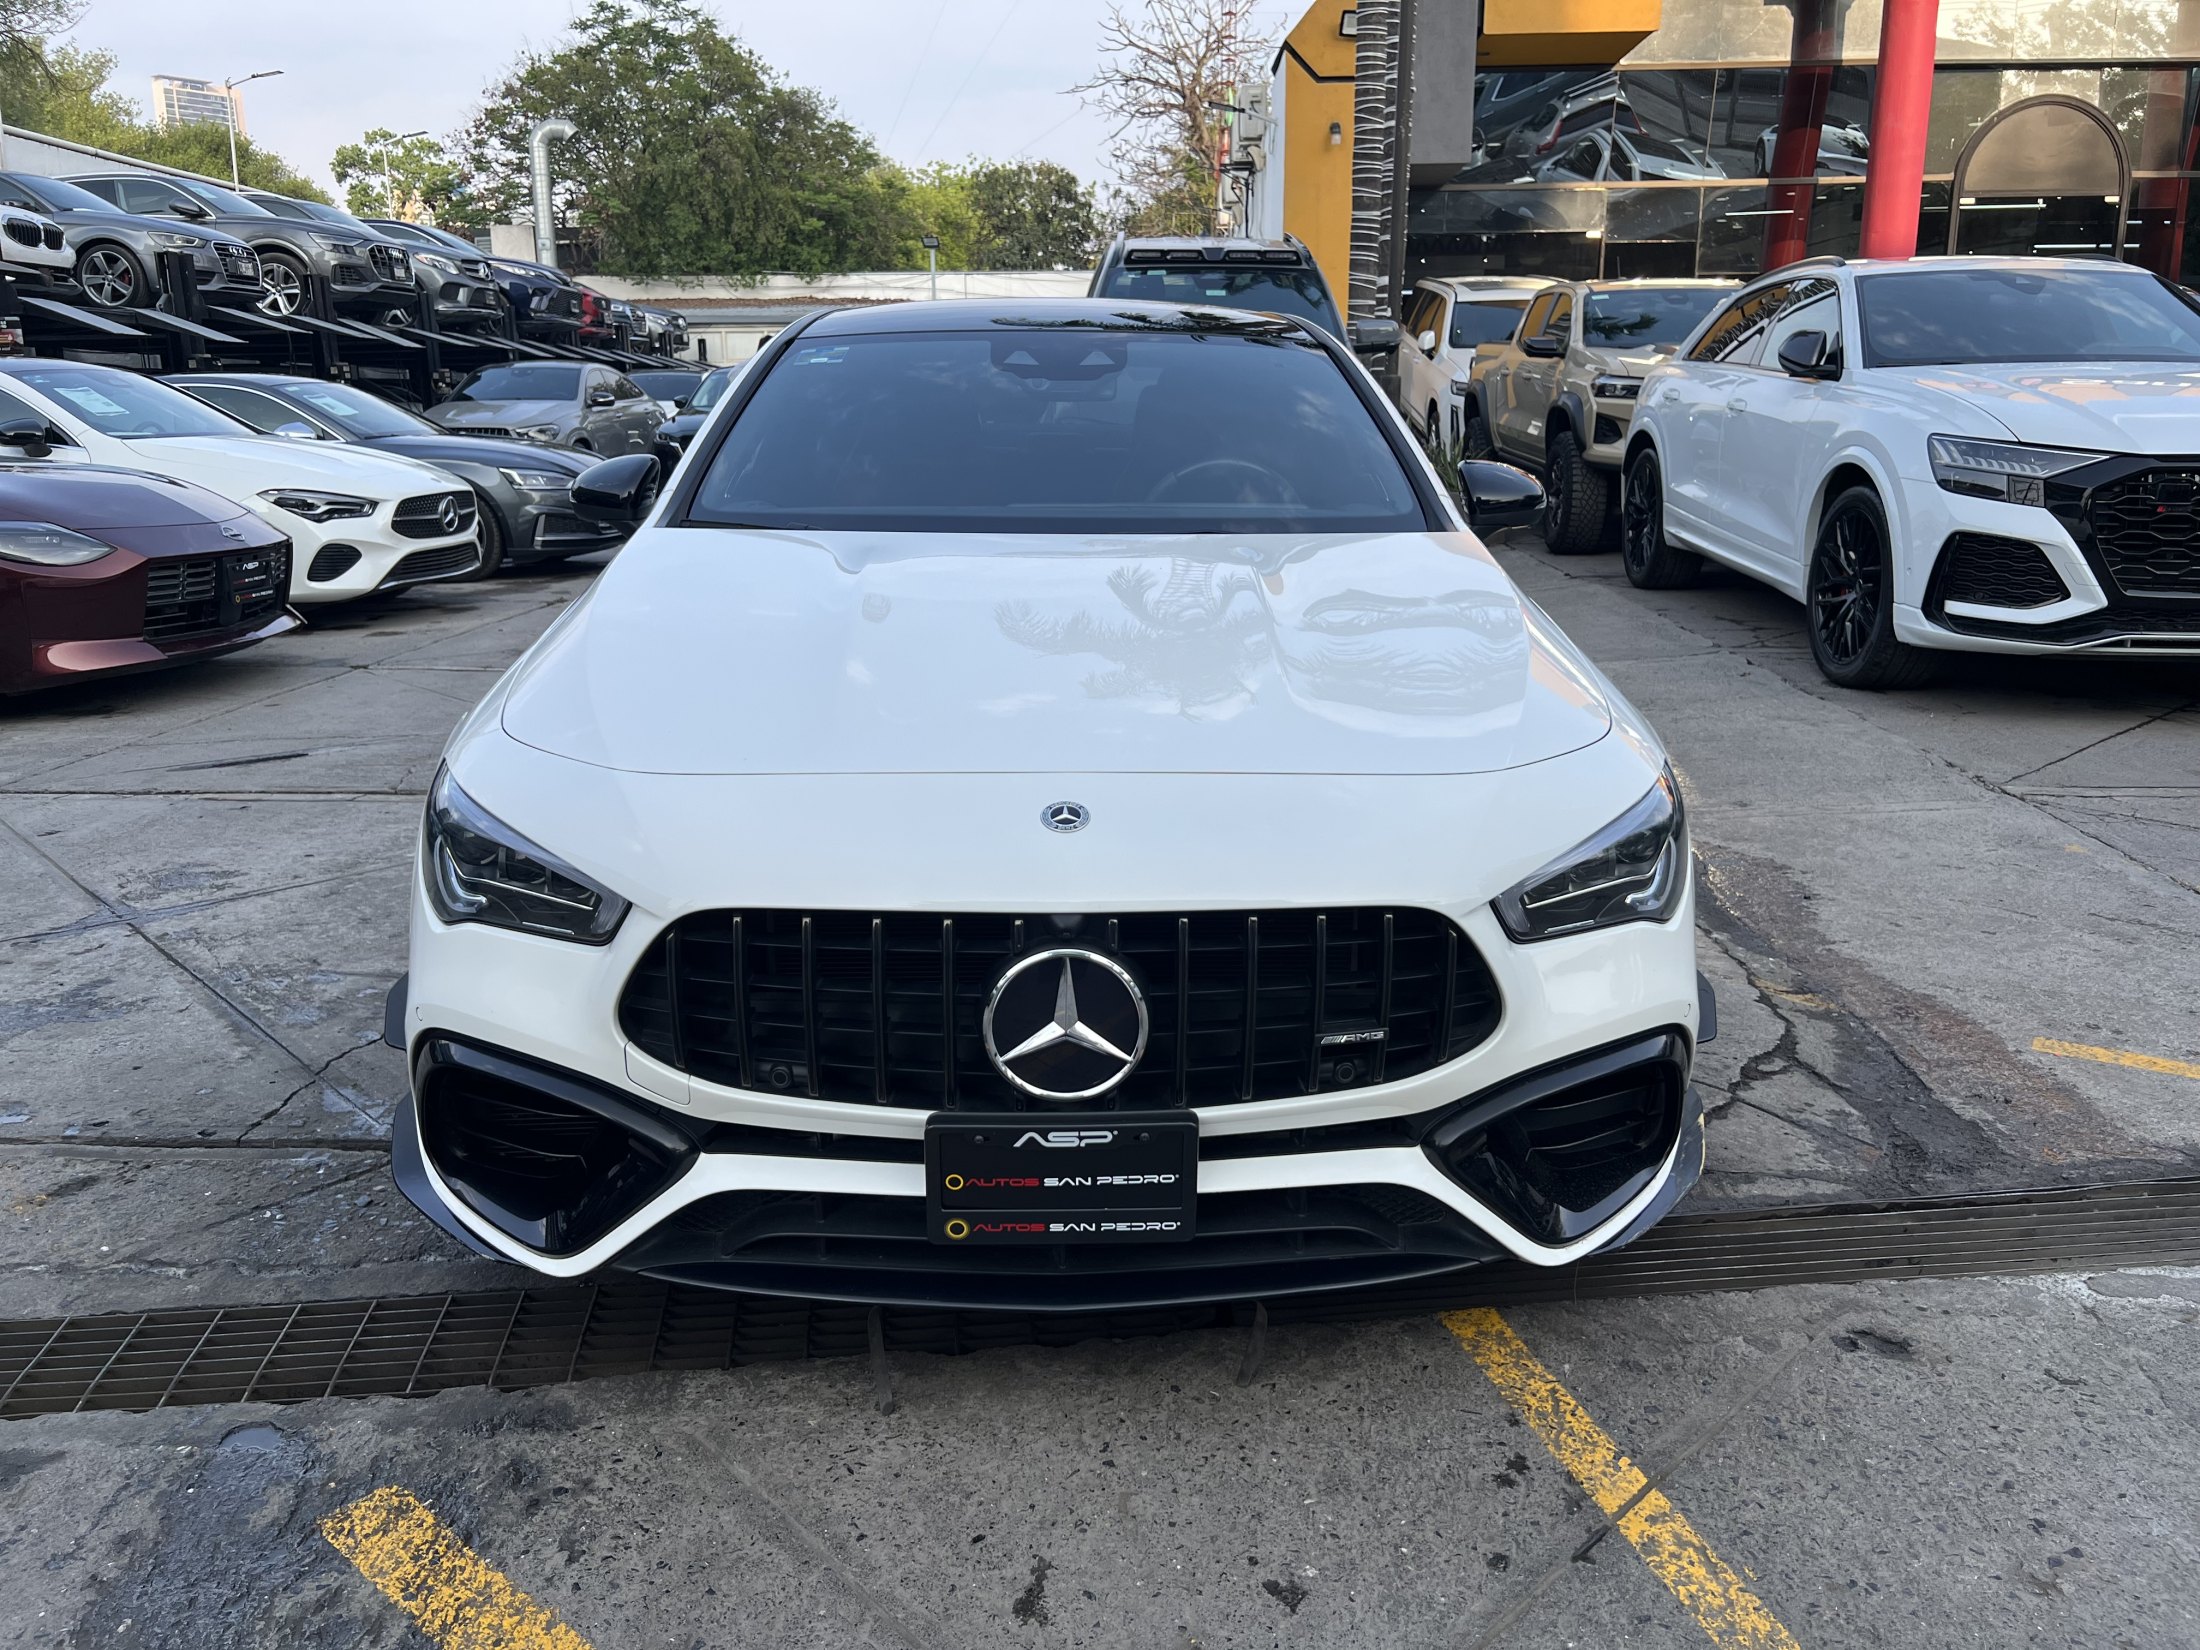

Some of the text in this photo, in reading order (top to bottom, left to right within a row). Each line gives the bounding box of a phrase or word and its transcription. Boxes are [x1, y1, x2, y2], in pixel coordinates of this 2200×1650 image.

[965, 1177, 1039, 1187] AUTOS
[1043, 1176, 1092, 1187] SAN
[973, 1223, 1046, 1232] AUTOS
[1049, 1222, 1096, 1232] SAN
